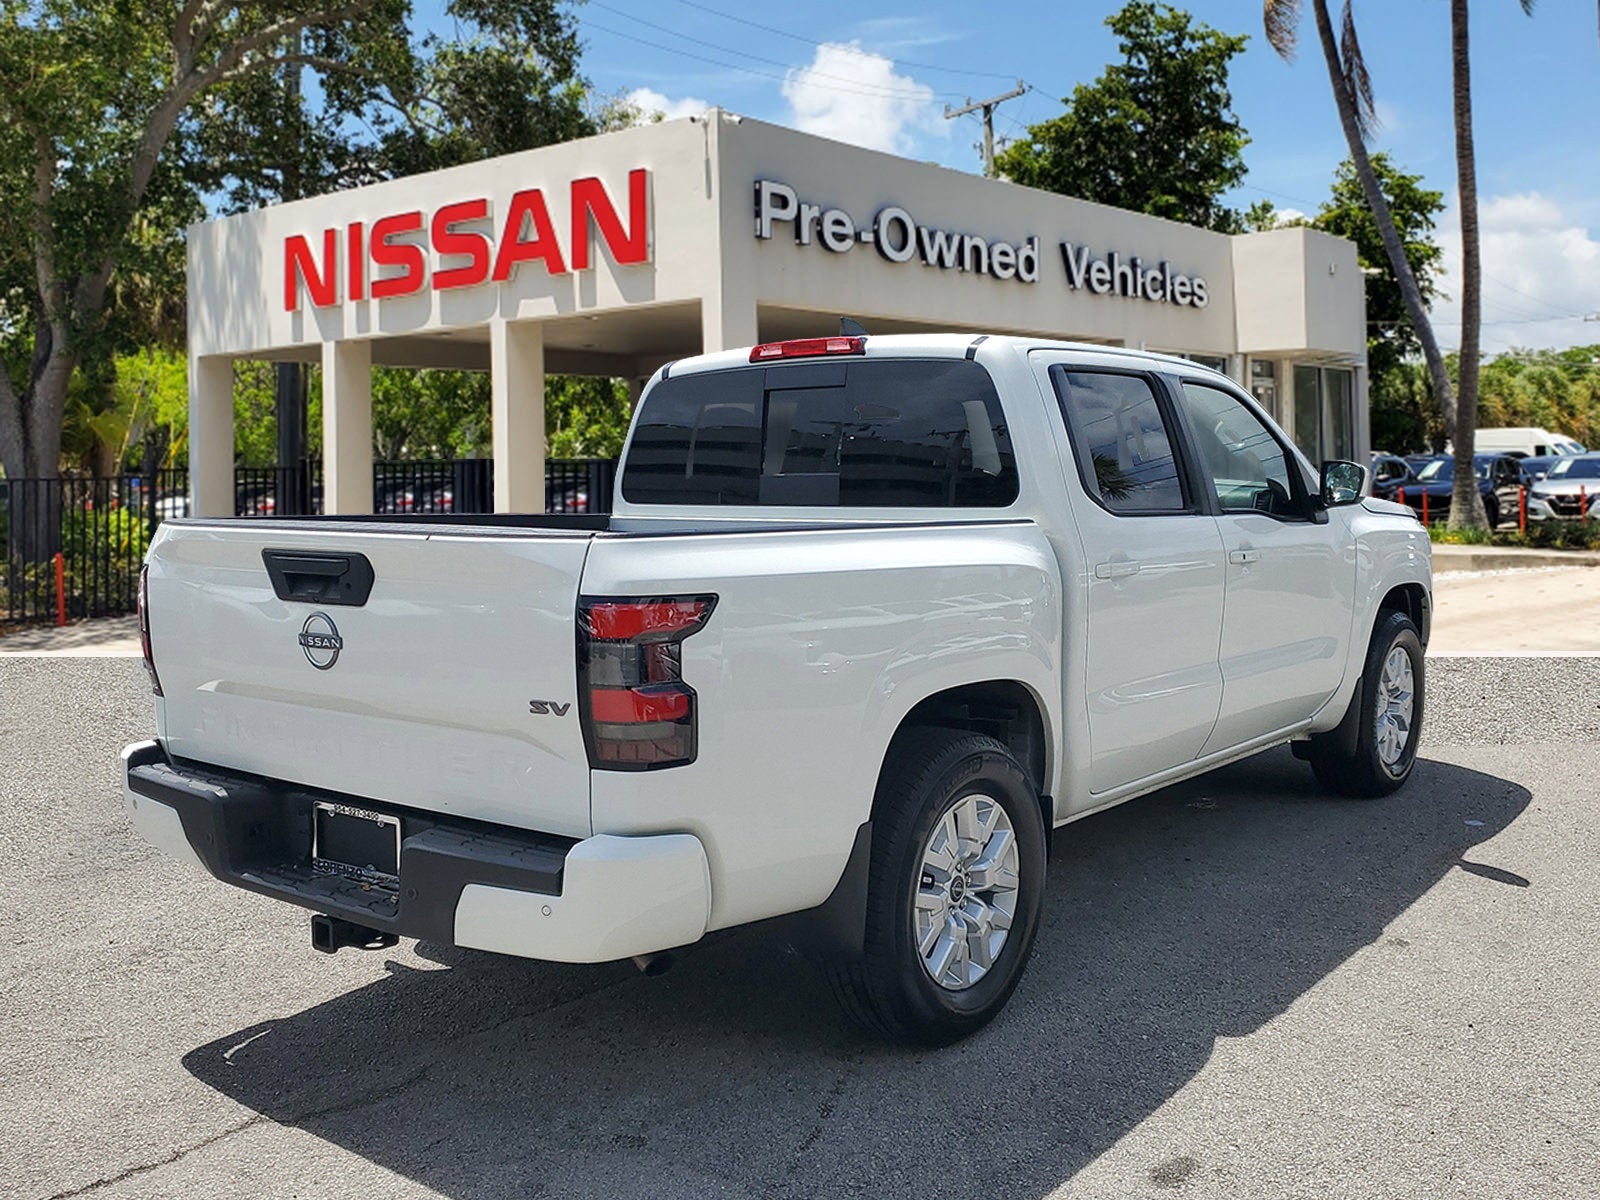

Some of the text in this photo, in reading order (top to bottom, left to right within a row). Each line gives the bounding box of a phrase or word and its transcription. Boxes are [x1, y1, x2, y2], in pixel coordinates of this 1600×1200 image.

[284, 168, 648, 312] NISSAN
[754, 180, 1209, 309] Pre-Owned Vehicles
[299, 633, 341, 649] NISSAN
[529, 699, 571, 716] SV
